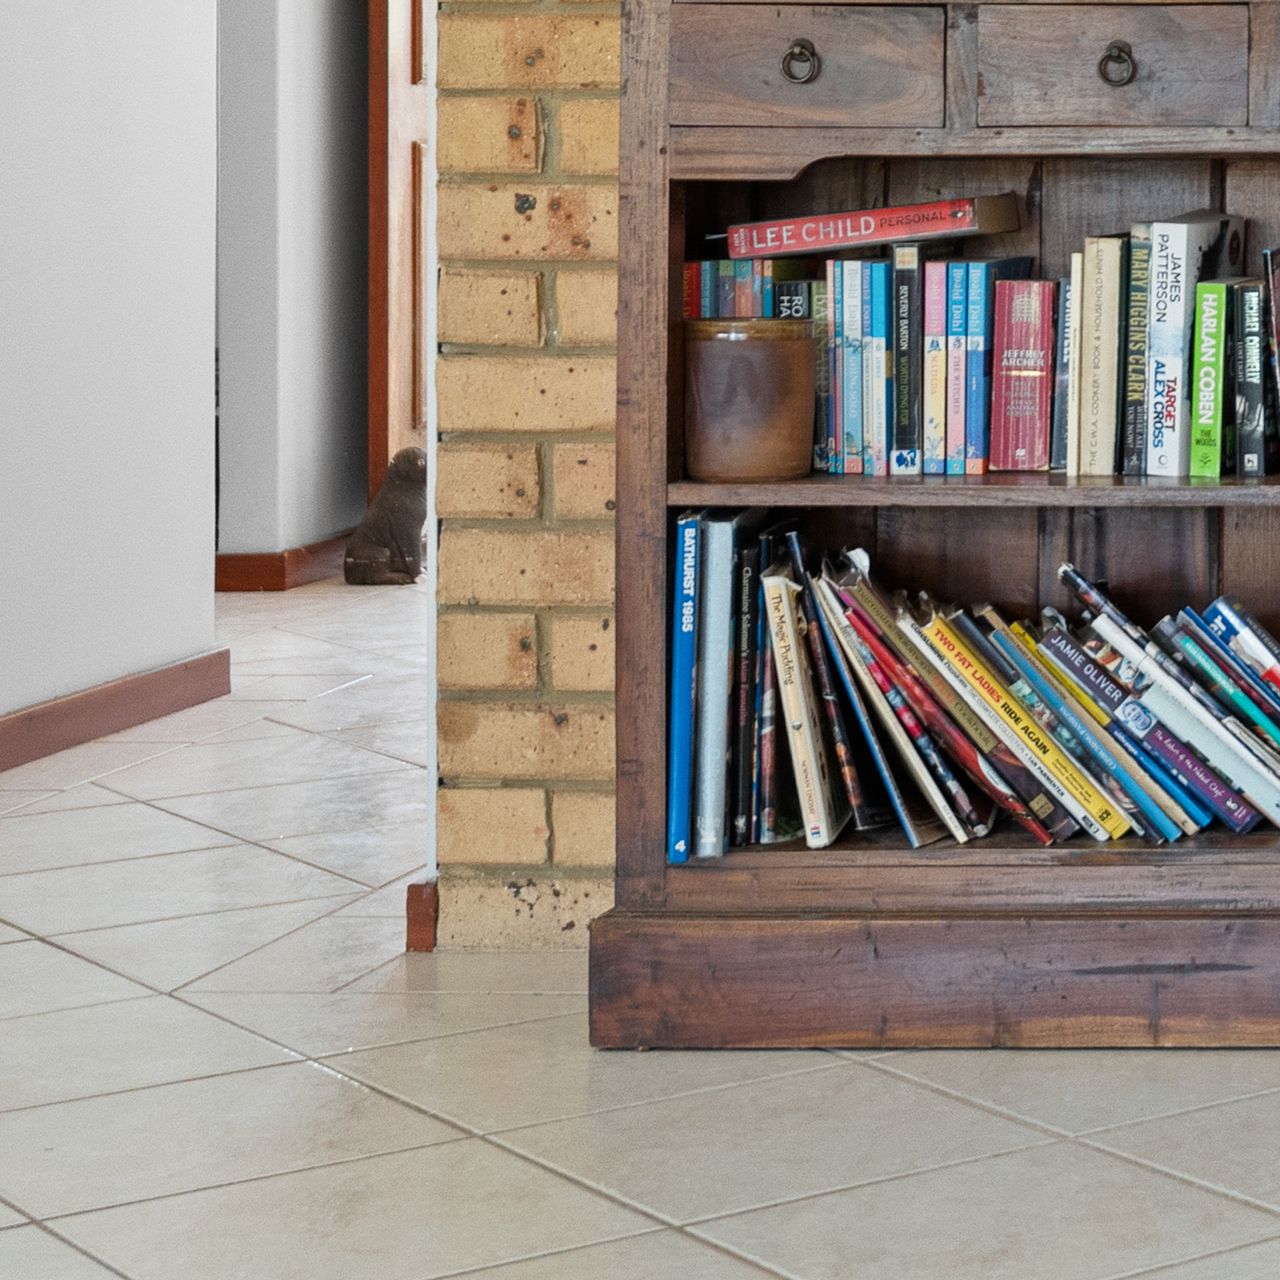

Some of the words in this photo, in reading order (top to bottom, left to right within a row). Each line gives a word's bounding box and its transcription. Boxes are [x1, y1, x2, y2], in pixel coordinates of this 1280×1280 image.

[752, 225, 797, 248] LEE
[801, 215, 876, 243] CHILD
[879, 211, 947, 228] PERSONAL
[952, 268, 964, 299] Roald
[969, 268, 982, 299] Roald
[1131, 248, 1149, 287] MARY
[1156, 234, 1169, 323] PATTERSON
[1169, 253, 1182, 303] JAMES
[900, 285, 909, 318] BEVERLY
[952, 304, 964, 332] Dahl
[969, 304, 982, 332] Dahl
[1094, 277, 1103, 332] HOUSEHOLD
[1129, 291, 1148, 351] HIGGINS
[1244, 291, 1260, 333] MICHAEL
[900, 319, 909, 350] BARTON
[1200, 293, 1218, 363] HARLAN
[1002, 358, 1045, 367] ARCHER
[1003, 349, 1045, 359] JEFFREY
[1092, 345, 1102, 370] BOOK
[1245, 336, 1261, 384] CONNELLY
[953, 374, 961, 415] WITCHES
[1091, 373, 1101, 416] COOKERY
[1127, 355, 1146, 401] CLARK
[1153, 360, 1166, 398] ALEX
[1198, 366, 1216, 424] COBEN
[1164, 377, 1177, 432] TARGET
[1152, 401, 1165, 448] CROSS
[1089, 451, 1098, 466] THE
[683, 527, 696, 597] BATHURST
[742, 567, 752, 612] Charmaine
[771, 593, 783, 612] The
[682, 600, 694, 633] 1985
[775, 615, 787, 644] Magic
[1246, 617, 1280, 655] WESTERN
[780, 645, 794, 685] Pudding
[1050, 635, 1086, 668] JAMIE
[1083, 663, 1123, 702] OLIVER
[934, 627, 956, 651] TWO
[954, 650, 974, 671] FAT
[971, 669, 1003, 704] LADIES
[1000, 701, 1023, 726] RIDE
[1021, 725, 1050, 756] AGAIN
[1035, 765, 1066, 797] PARMENTER
[1208, 782, 1225, 798] Chef
